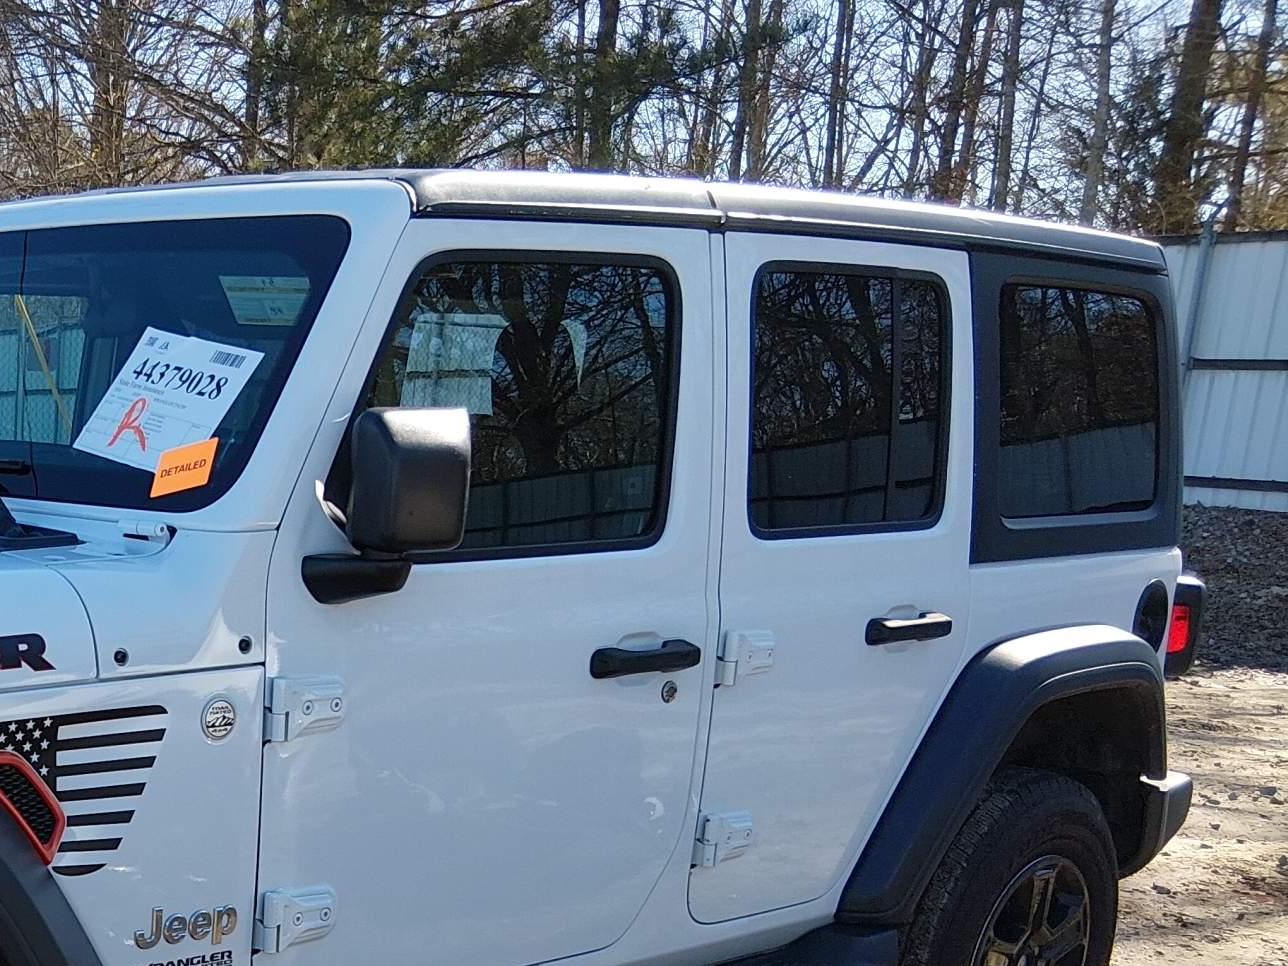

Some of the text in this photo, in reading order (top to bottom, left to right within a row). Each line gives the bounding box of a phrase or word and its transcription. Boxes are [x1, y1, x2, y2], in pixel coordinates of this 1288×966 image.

[133, 357, 229, 400] 44379028
[106, 397, 147, 453] R
[160, 458, 207, 478] DETAILED
[134, 904, 237, 950] Jeep
